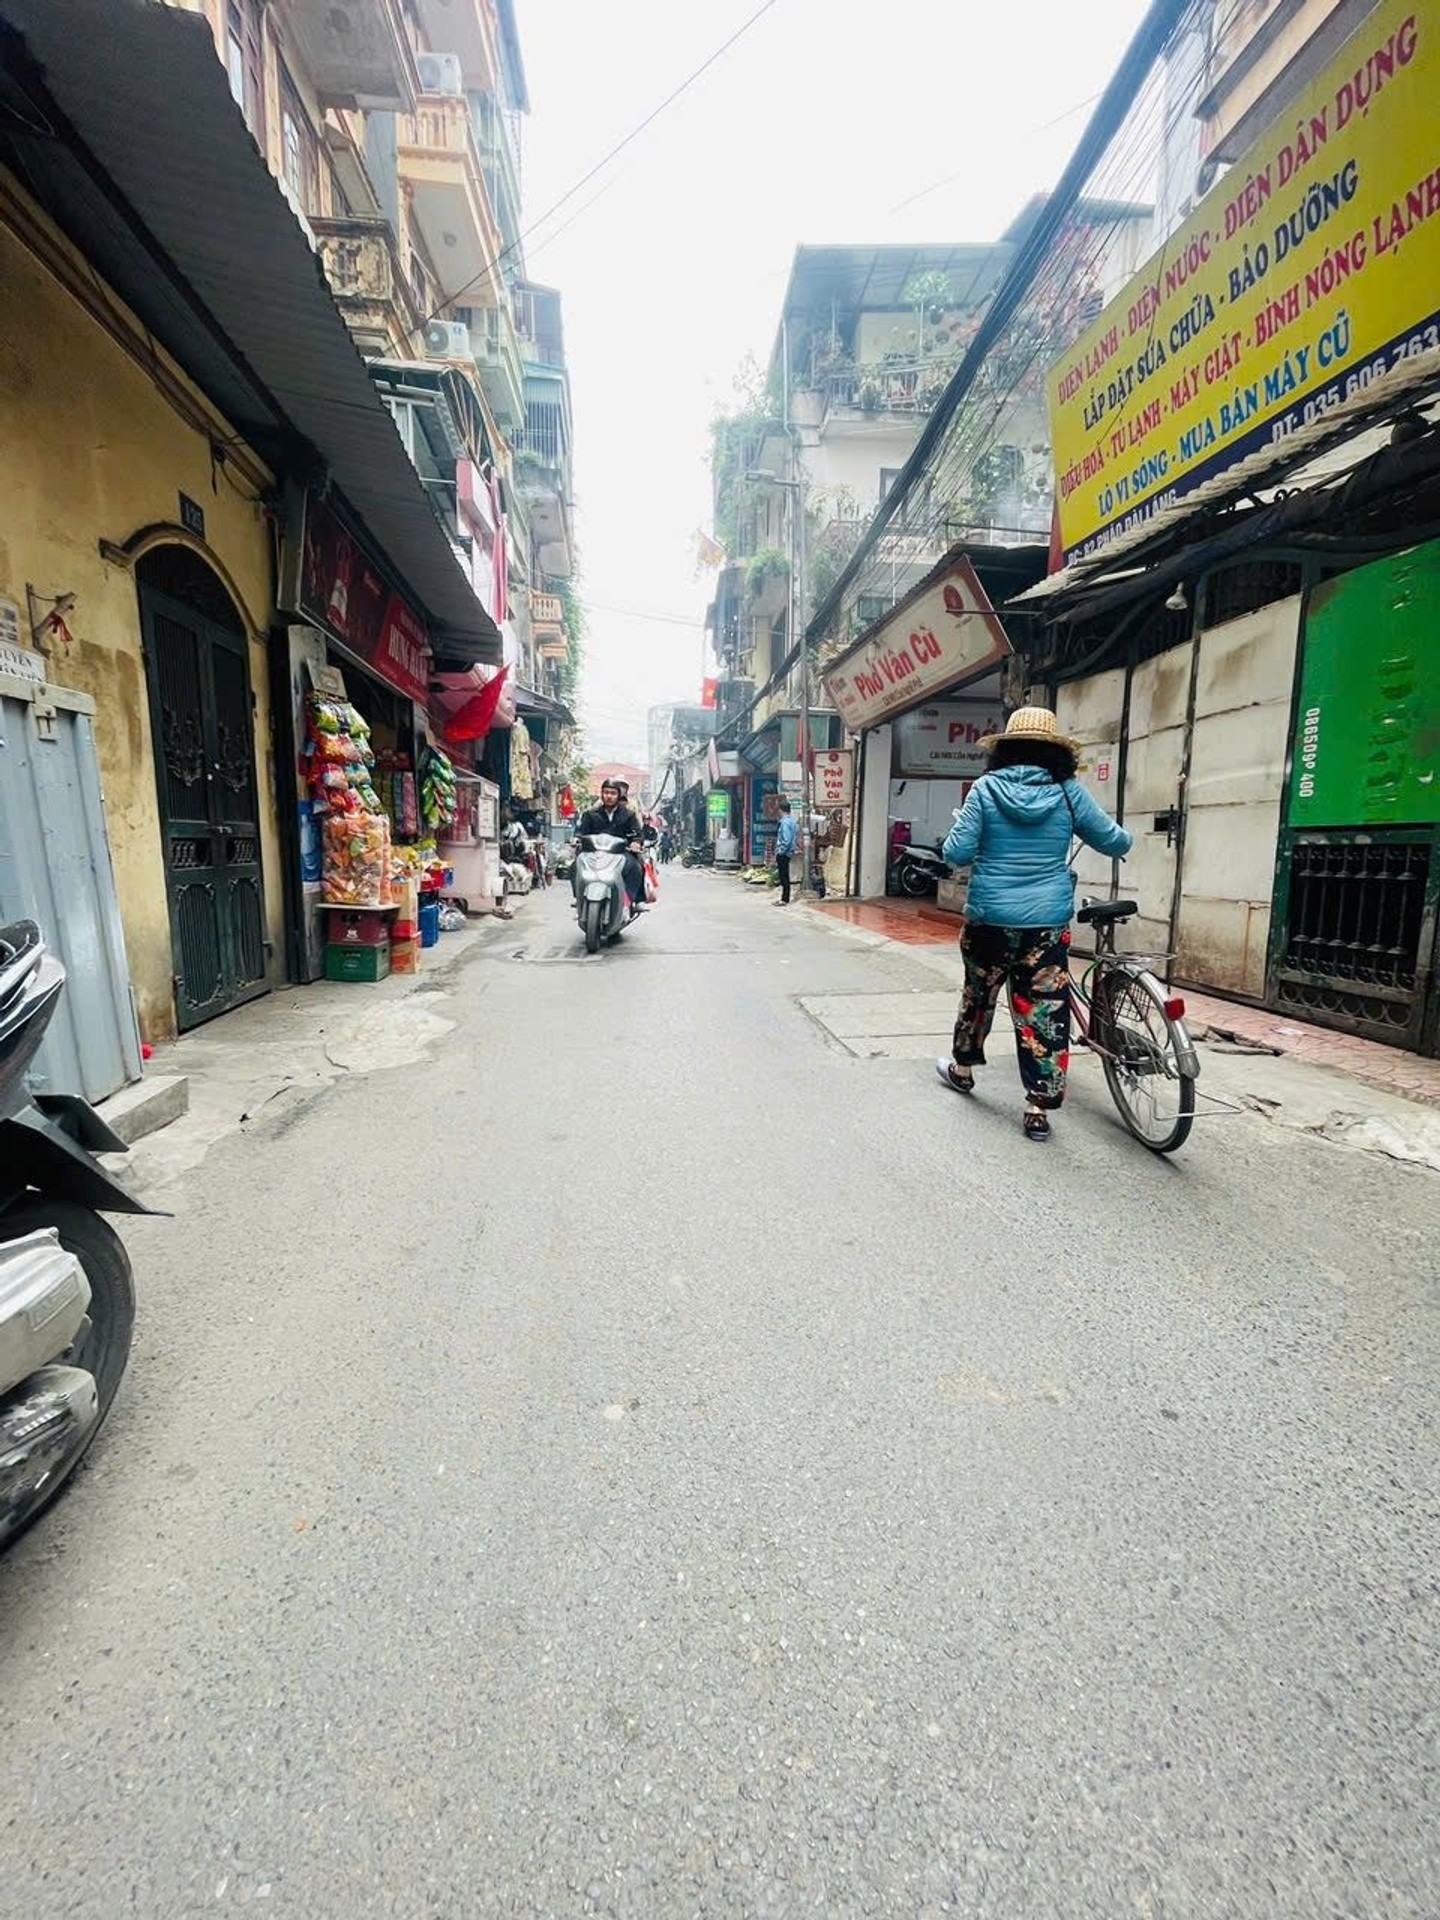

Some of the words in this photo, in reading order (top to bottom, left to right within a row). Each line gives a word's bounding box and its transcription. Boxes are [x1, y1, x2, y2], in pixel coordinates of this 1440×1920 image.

[1083, 387, 1105, 431] LẮP
[1170, 293, 1215, 353] CHỮA
[1229, 243, 1268, 303] BẢO
[1275, 159, 1358, 263] DƯỠNG
[1086, 326, 1118, 378] LẠNH
[1278, 106, 1327, 188] DÂN
[1336, 15, 1418, 131] DỤNG
[1128, 398, 1161, 446] LẠNH
[1170, 365, 1199, 414] MÁY
[1205, 331, 1241, 384] GIẶT
[1255, 283, 1300, 347] BÌNH
[1305, 231, 1367, 308] NÓNG
[1373, 165, 1440, 256] LẠNH
[1098, 482, 1113, 516] LÒ
[1116, 476, 1129, 505] VI
[1132, 449, 1168, 494] SÓNG
[1180, 416, 1216, 463] MUA
[1220, 382, 1258, 436] BÁN
[1264, 345, 1310, 407] MÁY
[1318, 308, 1349, 368] CŨ
[1346, 357, 1386, 395] 606
